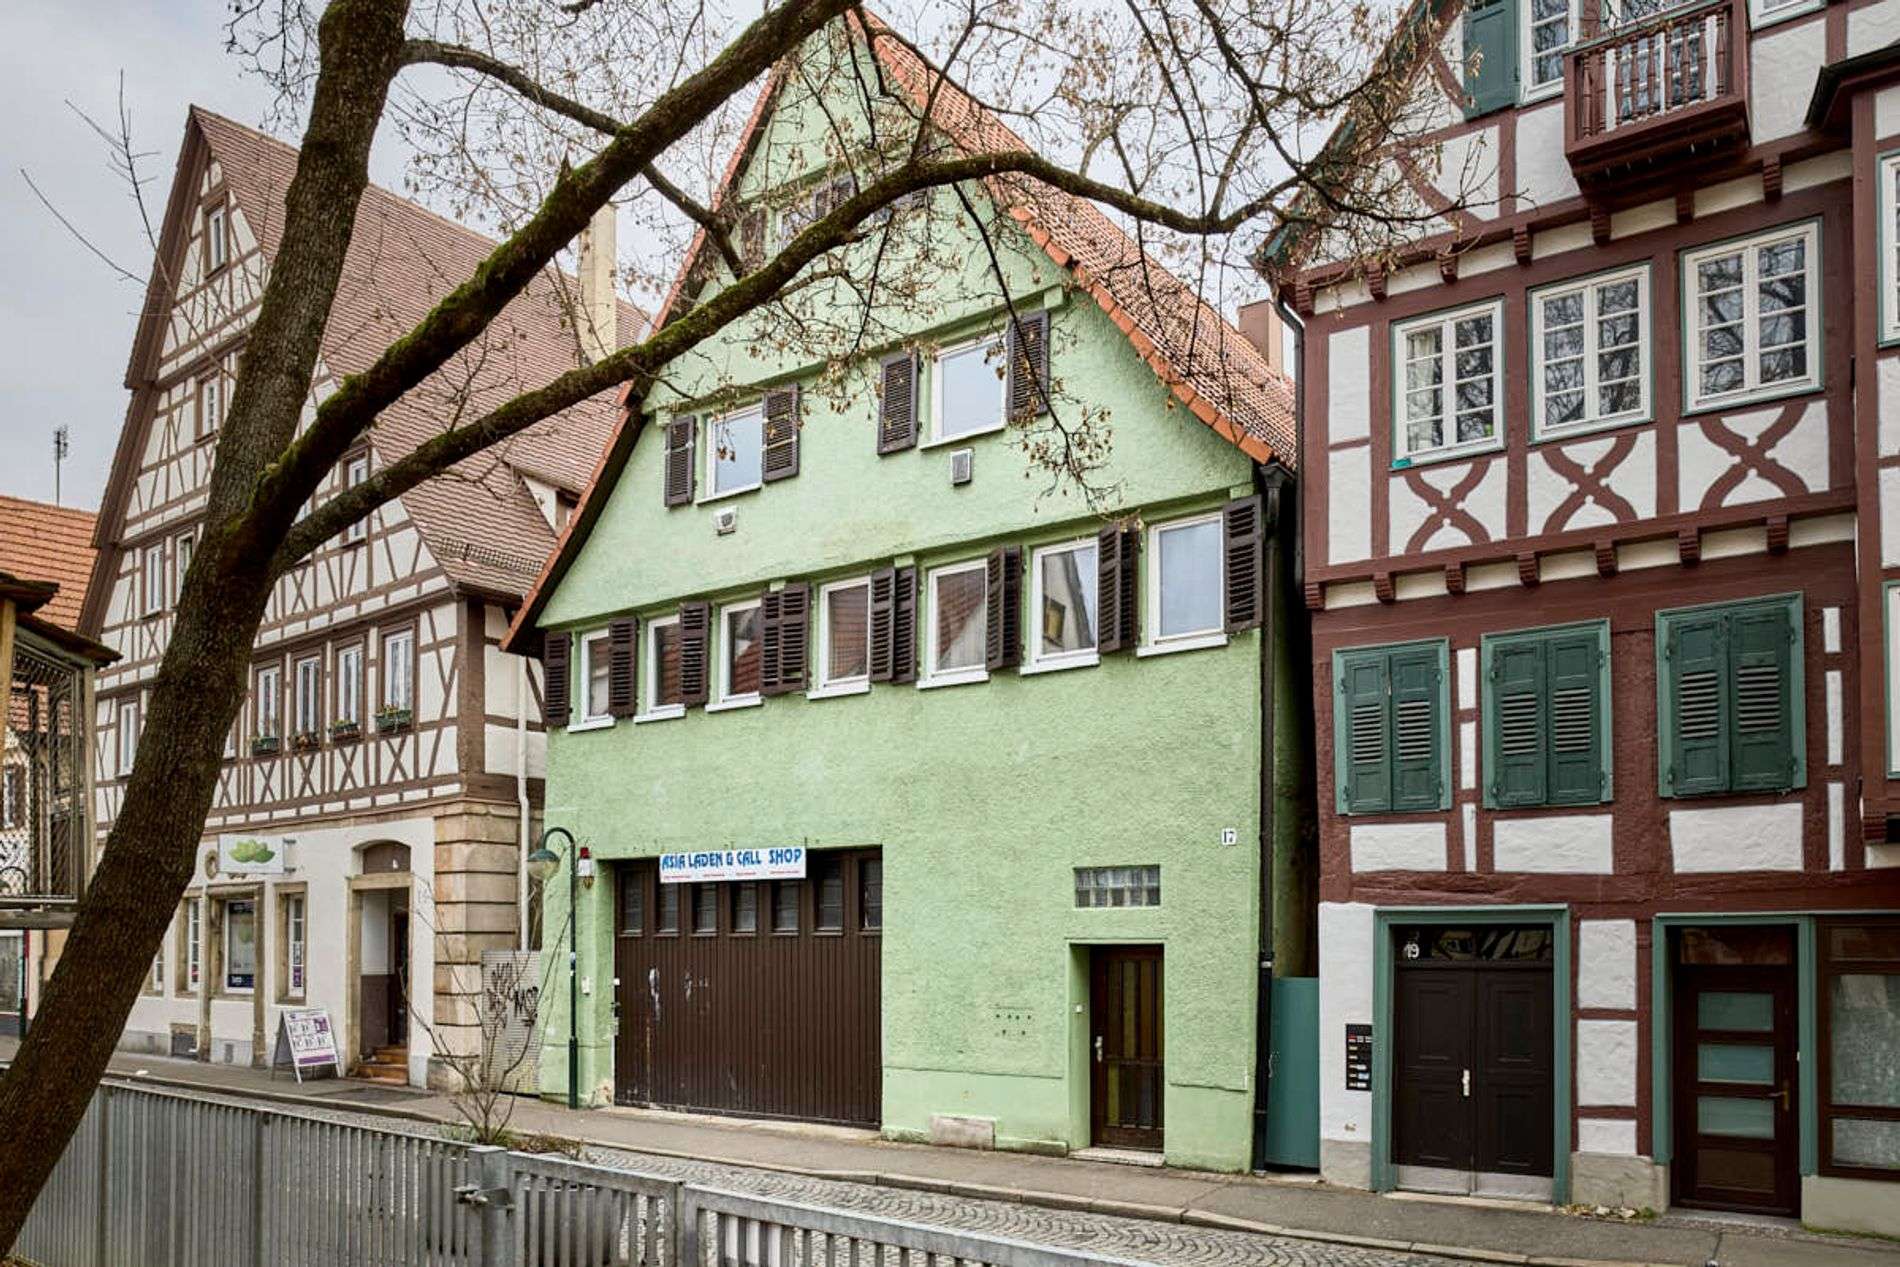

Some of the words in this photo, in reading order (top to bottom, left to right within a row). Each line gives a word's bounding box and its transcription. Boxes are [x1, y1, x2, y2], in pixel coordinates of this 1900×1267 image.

[1224, 831, 1235, 843] 17
[688, 851, 724, 869] LADEN
[736, 849, 762, 867] CALL
[769, 848, 802, 865] SHOP
[1403, 943, 1420, 958] 19
